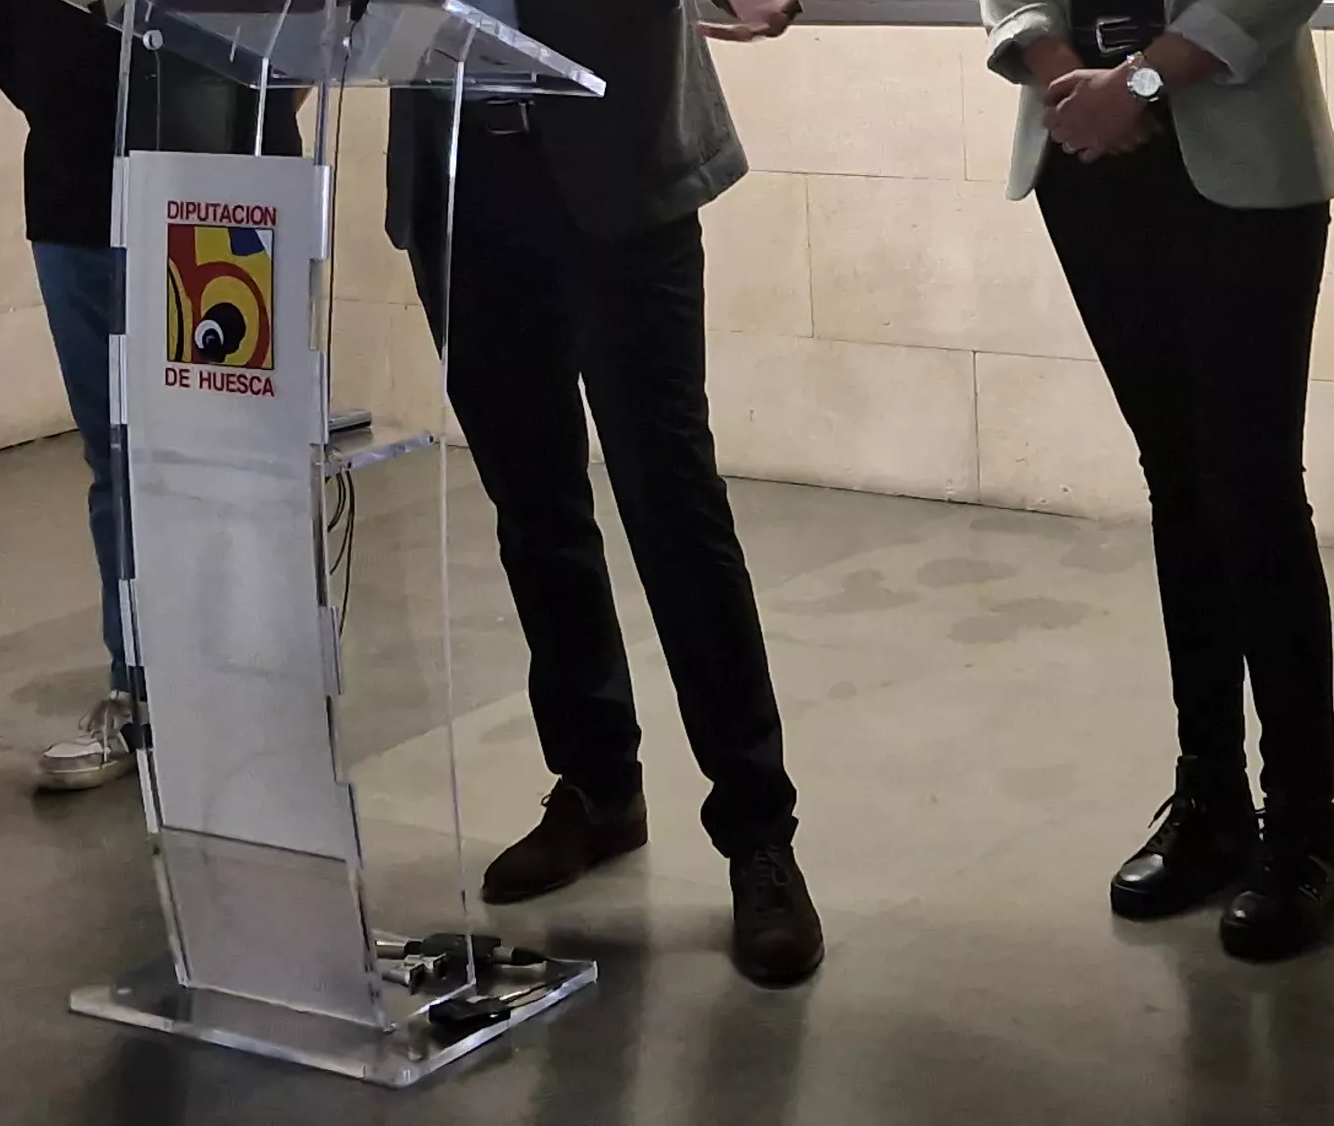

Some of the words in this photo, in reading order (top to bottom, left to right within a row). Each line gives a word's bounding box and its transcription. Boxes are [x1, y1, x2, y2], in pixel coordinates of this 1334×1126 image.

[167, 200, 277, 226] DIPUTACION
[165, 367, 190, 388] DE
[199, 370, 275, 397] HUESCA
